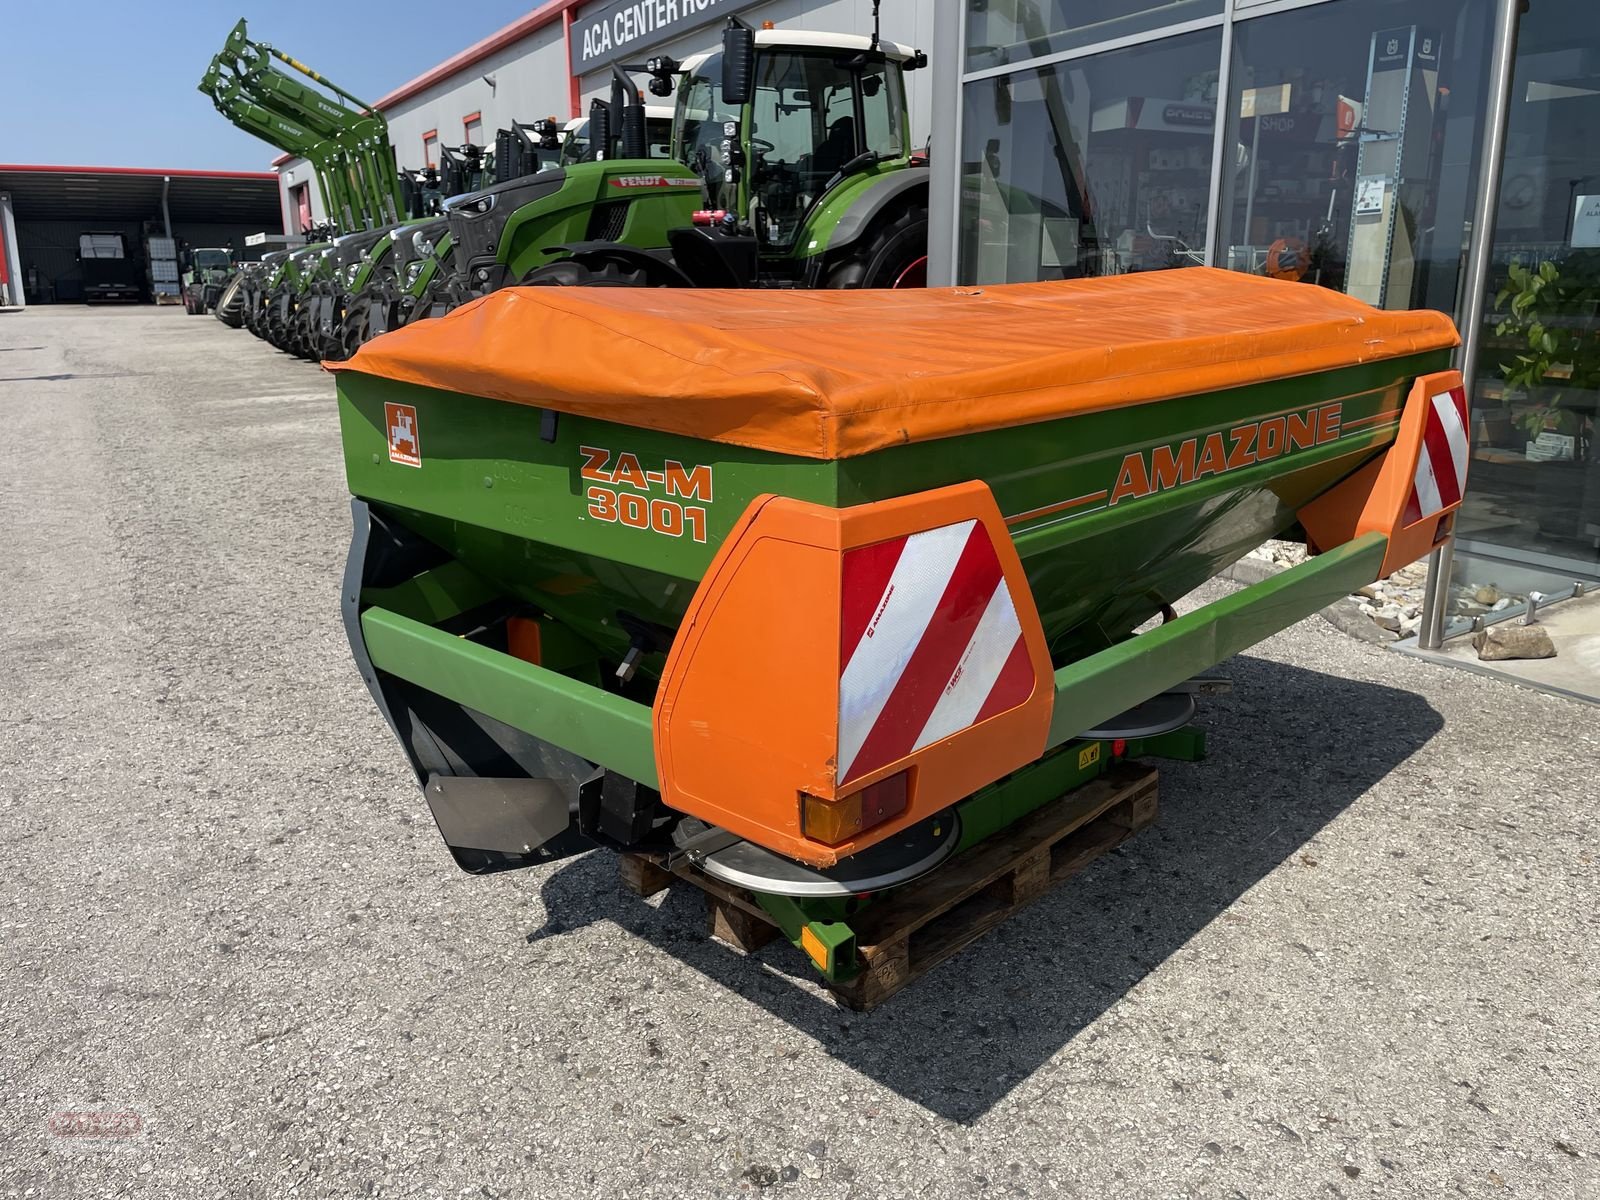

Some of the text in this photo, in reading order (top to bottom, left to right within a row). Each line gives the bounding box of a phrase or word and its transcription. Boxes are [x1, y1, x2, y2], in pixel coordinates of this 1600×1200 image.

[582, 0, 679, 61] ACA CENTER
[618, 175, 663, 187] FENDT
[579, 445, 714, 503] ZA-M
[1108, 402, 1343, 507] AMAZONE
[587, 486, 707, 544] 3001
